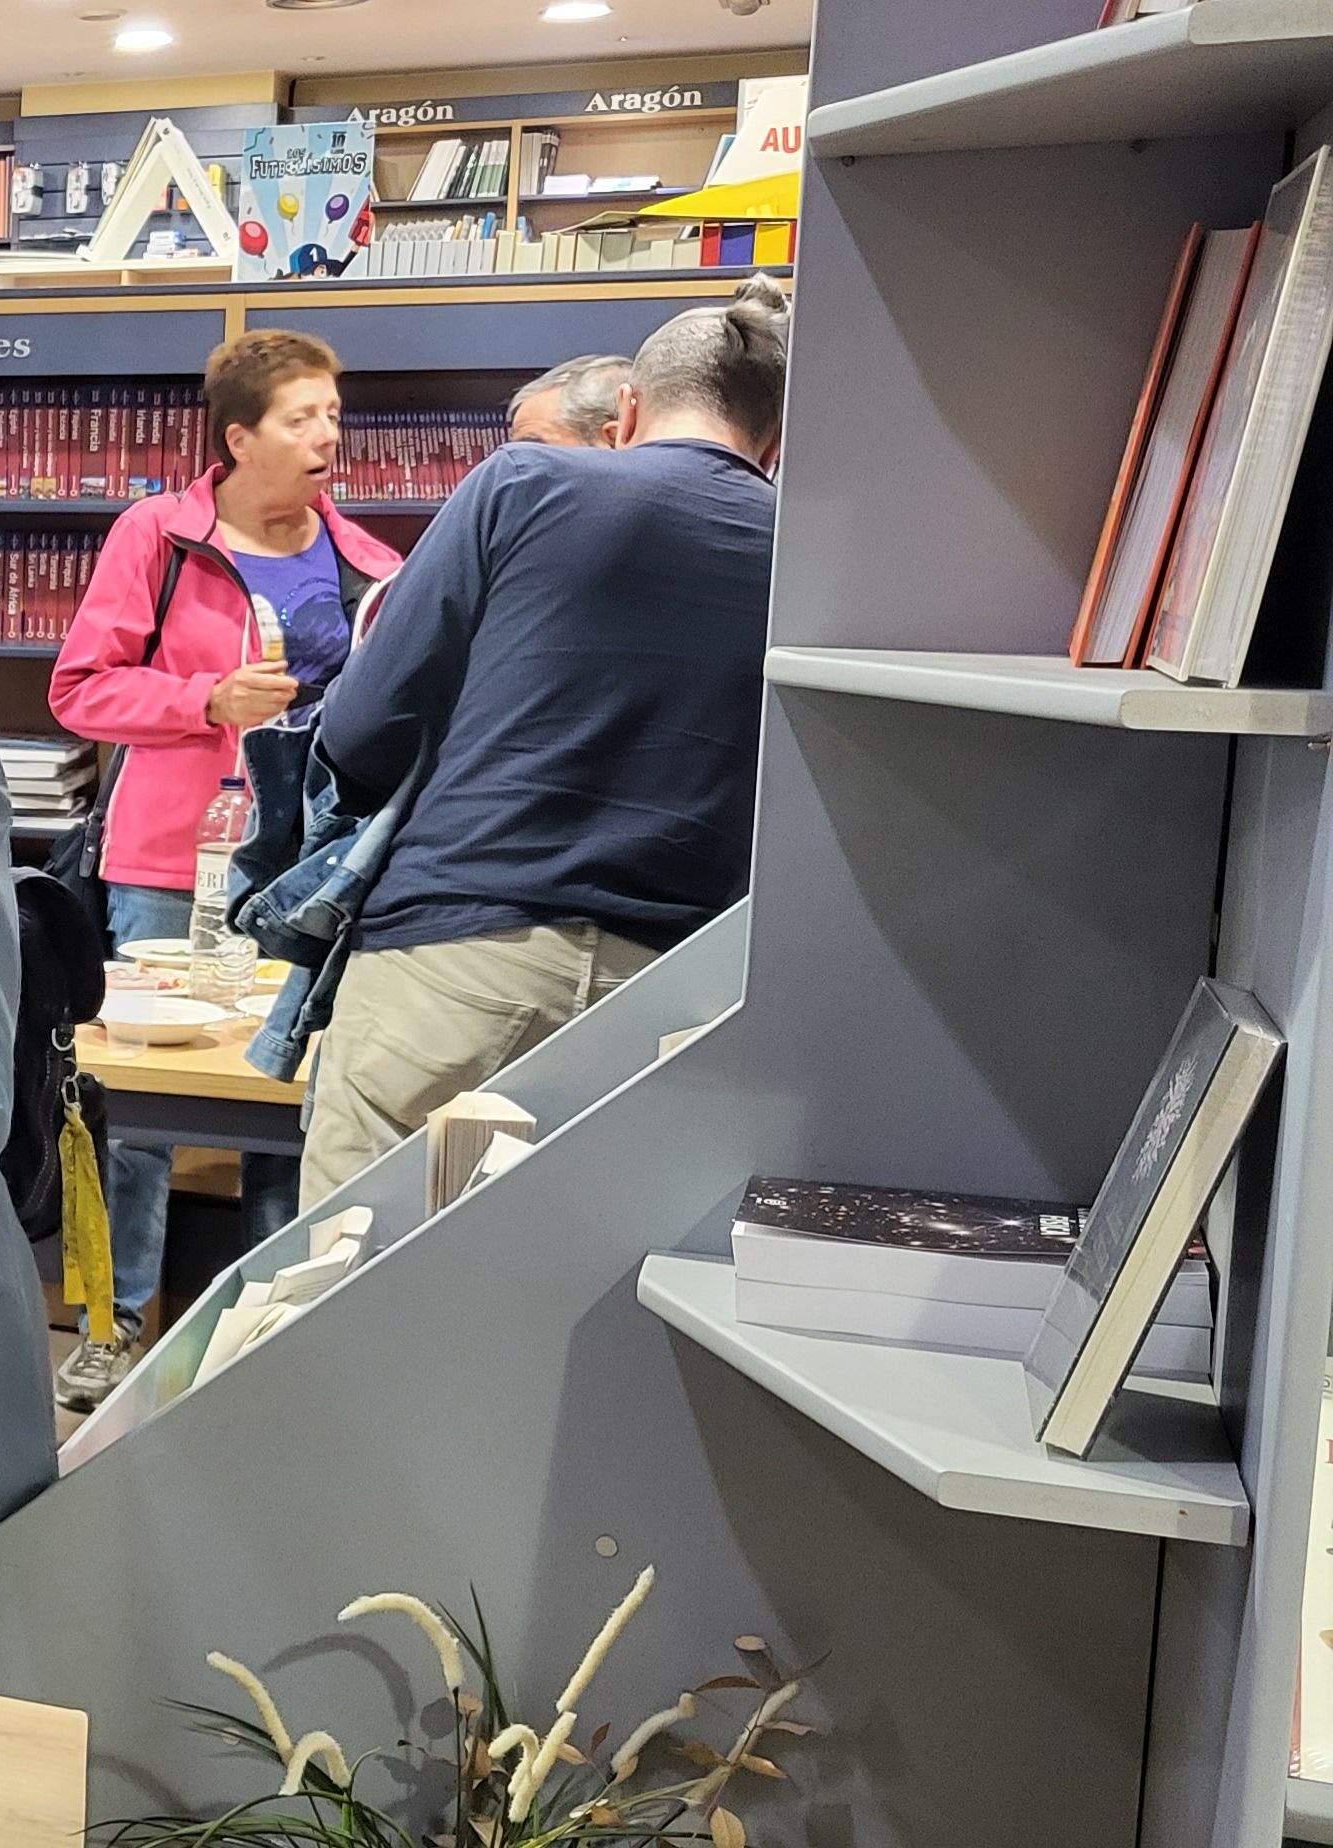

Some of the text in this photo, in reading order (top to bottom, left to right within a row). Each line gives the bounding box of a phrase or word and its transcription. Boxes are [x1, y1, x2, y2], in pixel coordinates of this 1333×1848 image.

[346, 99, 455, 127] Aragón
[584, 84, 703, 114] Aragón
[760, 126, 802, 154] AU
[90, 409, 101, 452] Francia
[136, 409, 146, 444] Irlanda
[152, 410, 161, 445] Islandia
[7, 553, 20, 615] Sur de África
